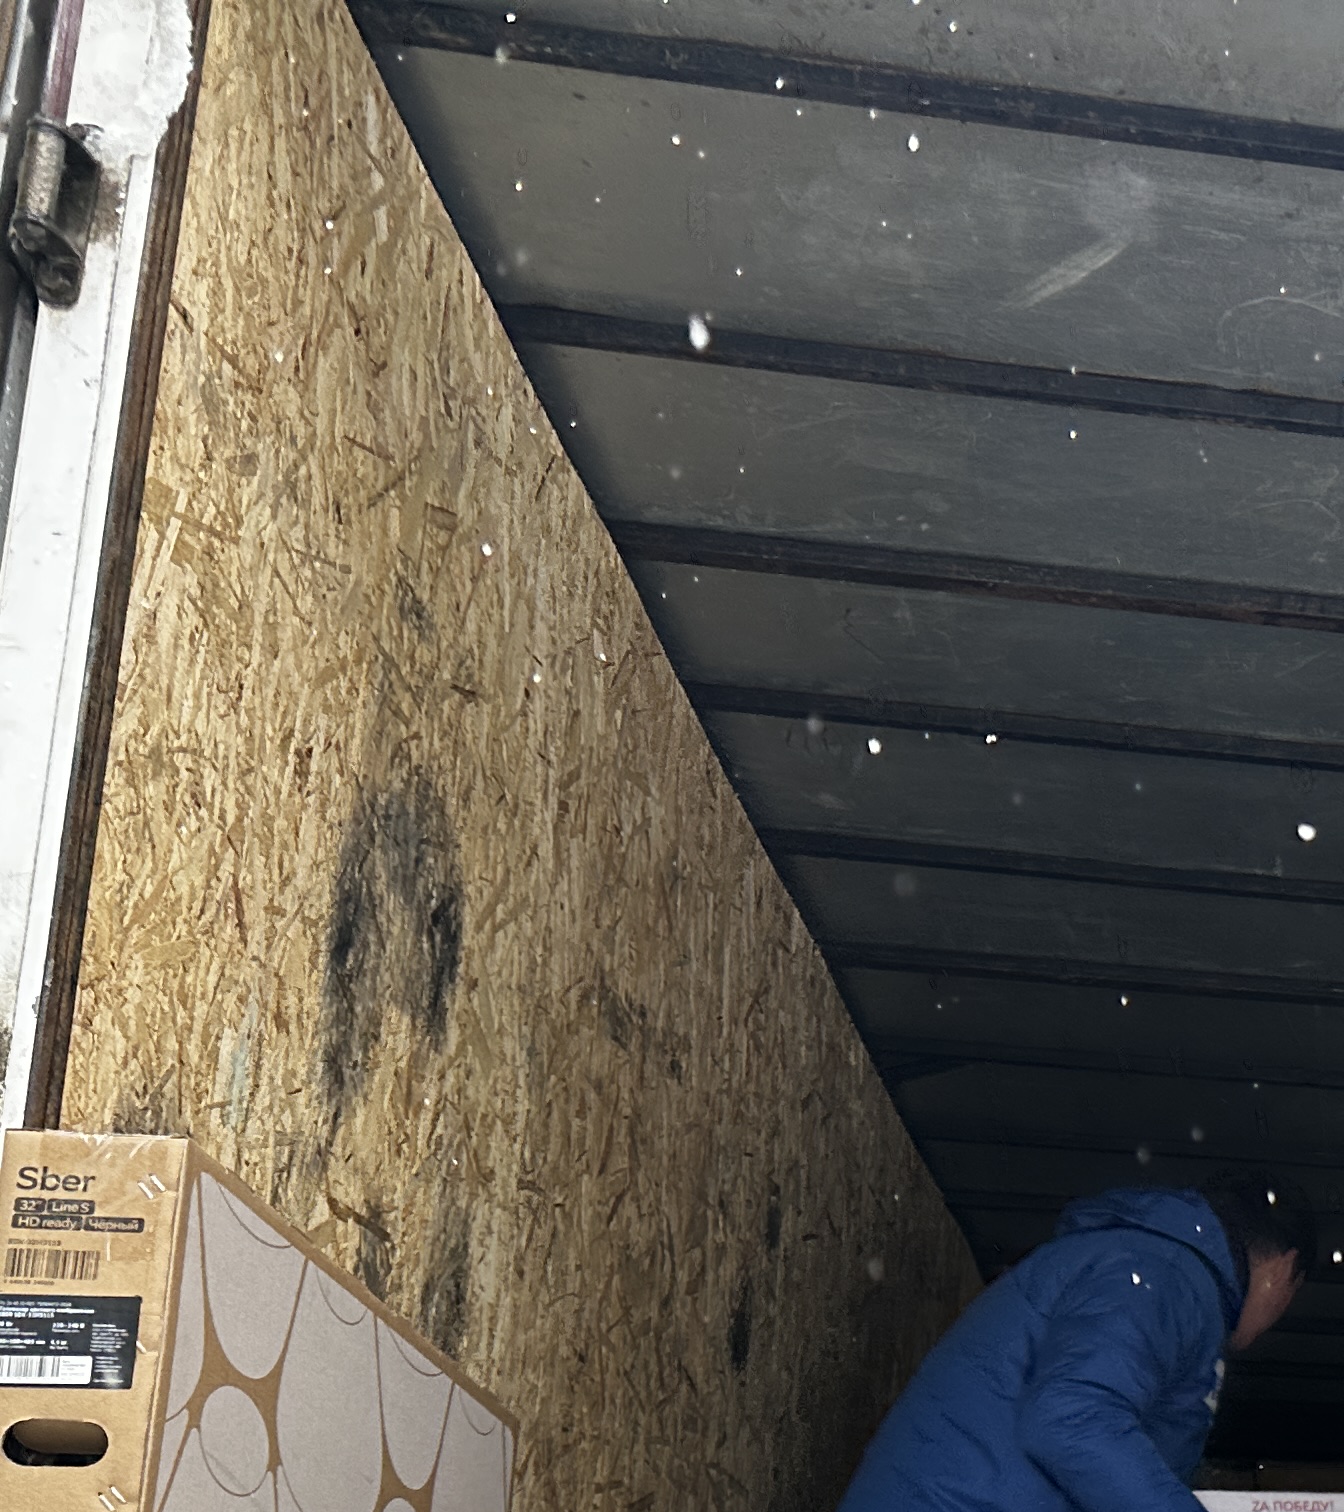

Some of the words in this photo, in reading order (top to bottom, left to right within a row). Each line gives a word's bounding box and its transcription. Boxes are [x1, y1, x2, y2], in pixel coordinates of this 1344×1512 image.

[16, 1166, 96, 1192] Sber
[52, 1202, 79, 1213] Line
[18, 1216, 40, 1227] HD
[42, 1218, 77, 1230] ready
[1273, 1500, 1334, 1512] ПОБЕДУ!
